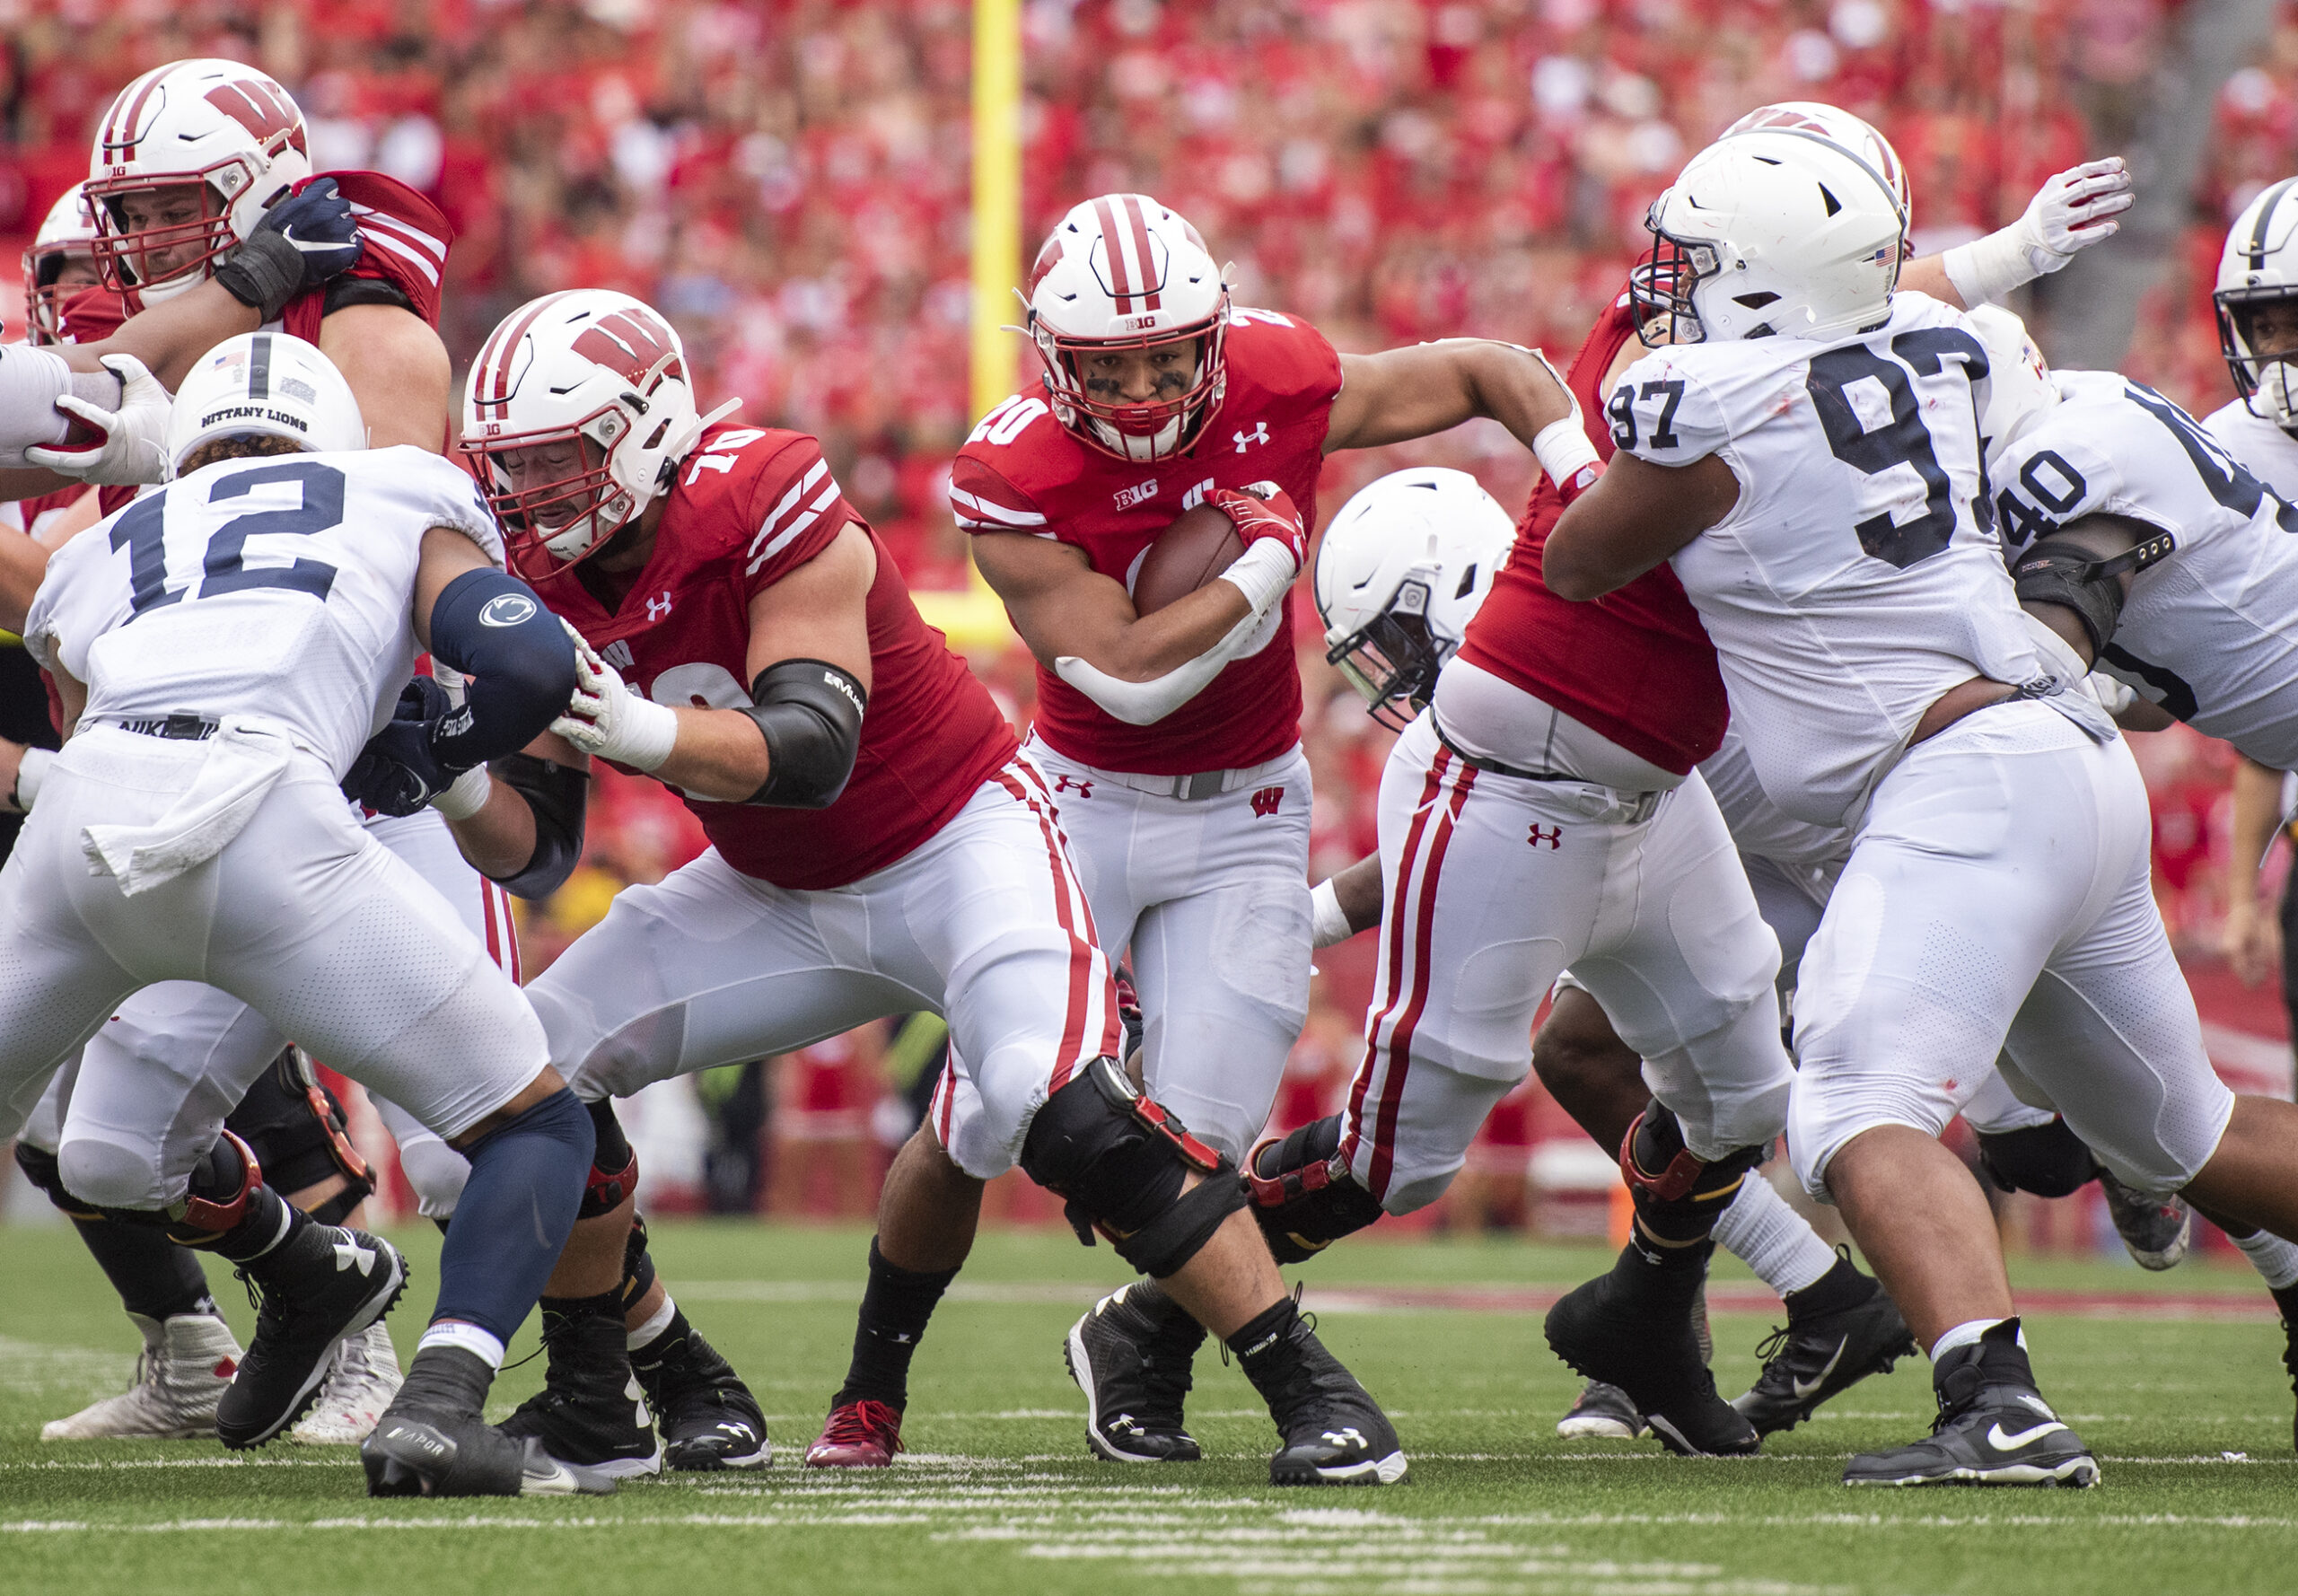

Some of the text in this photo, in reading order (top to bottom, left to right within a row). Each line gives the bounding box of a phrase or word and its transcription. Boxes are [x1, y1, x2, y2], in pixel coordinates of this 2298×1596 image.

[201, 407, 308, 433] NITTANY LIONS
[964, 394, 1049, 446] 20
[1604, 381, 1686, 450] 97
[1806, 326, 1995, 570] 97
[1996, 450, 2087, 547] 40
[109, 460, 346, 627] 12
